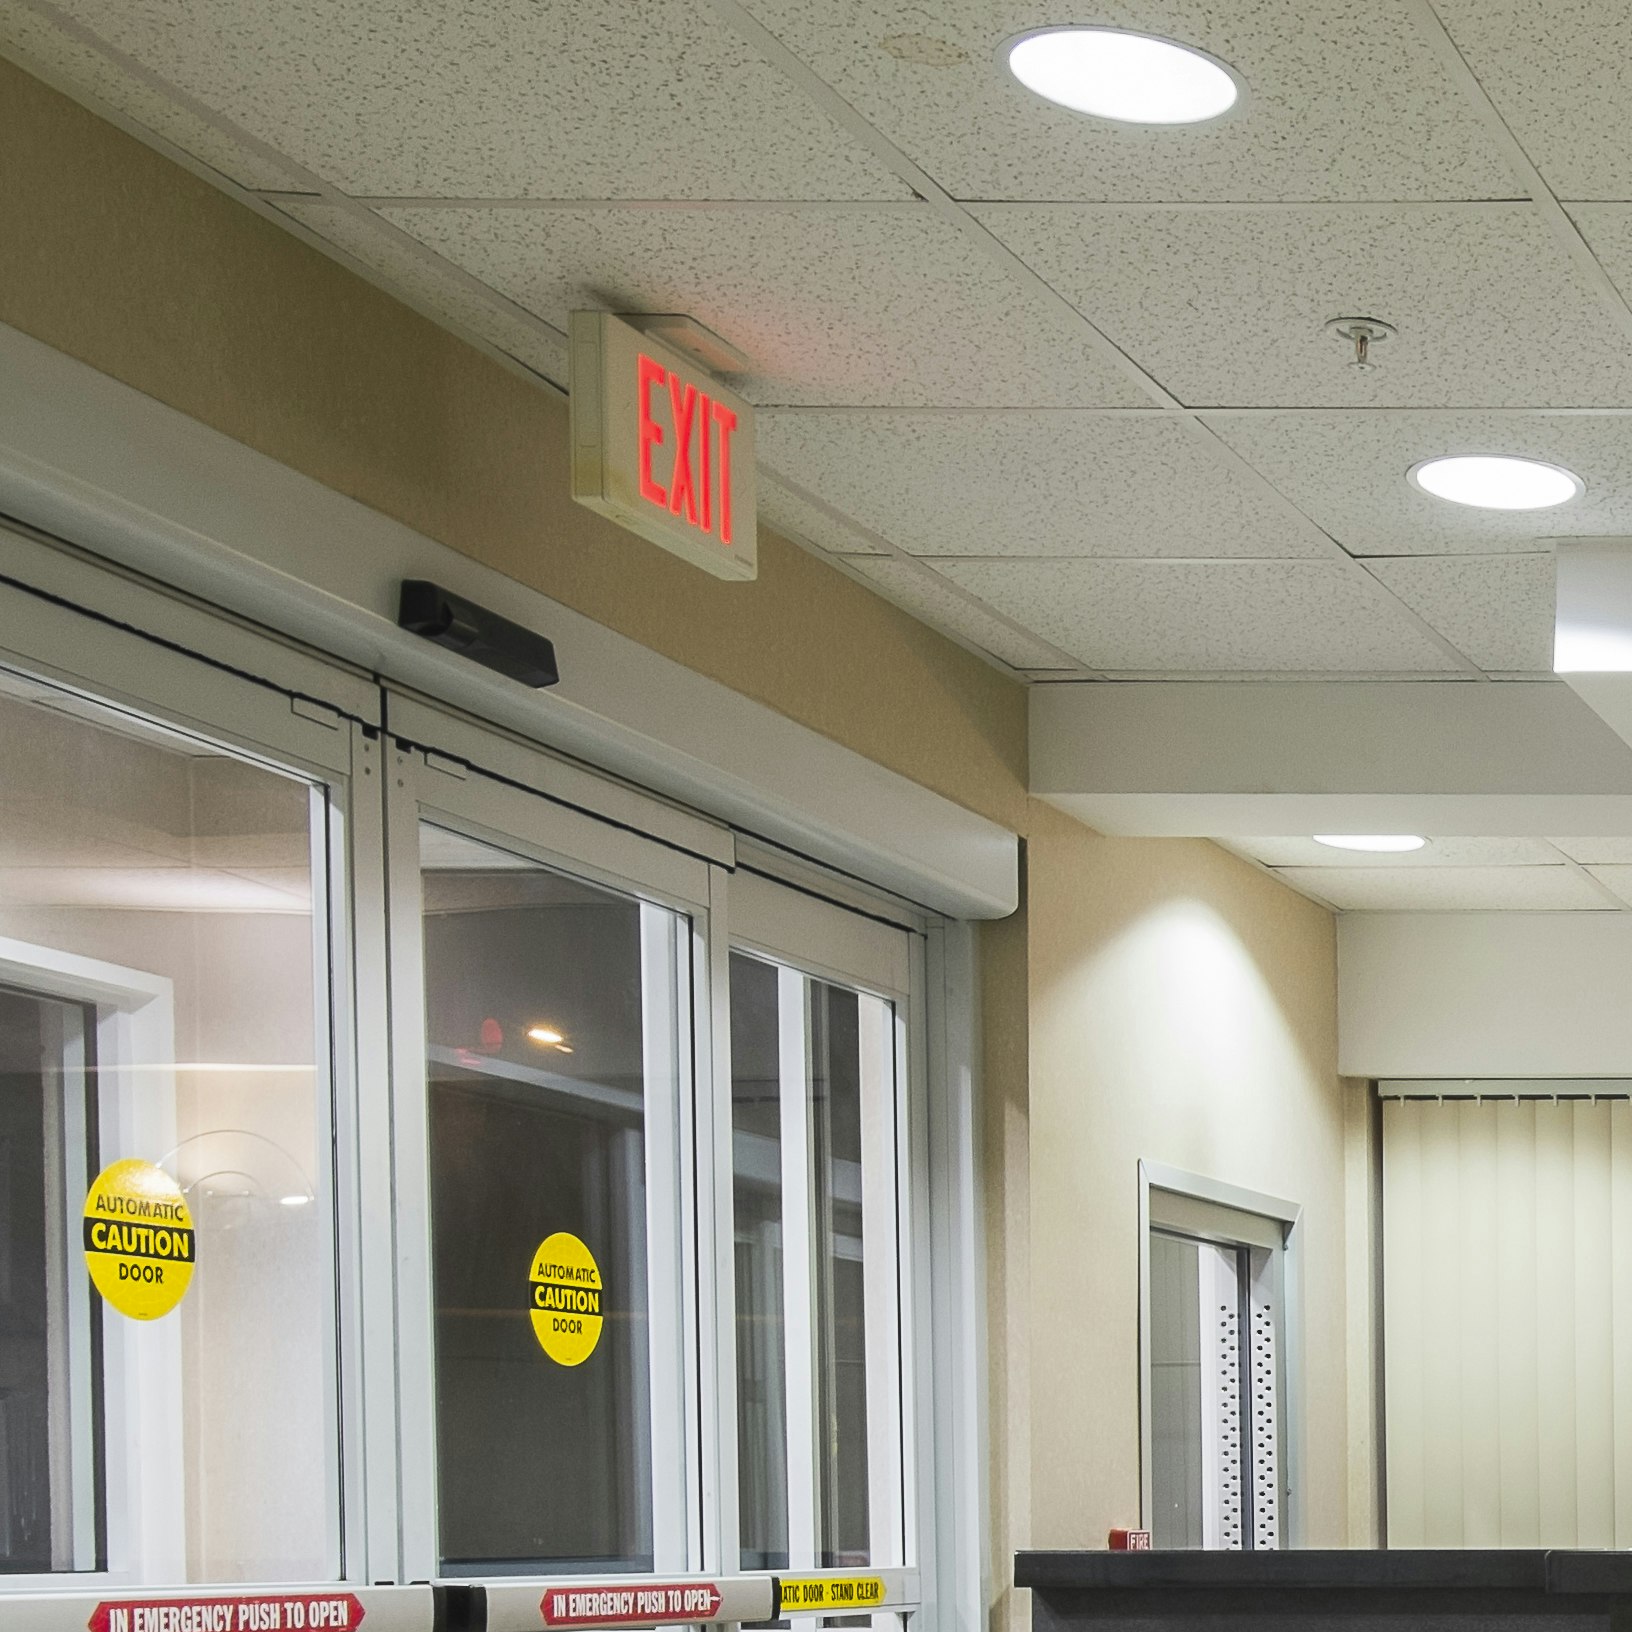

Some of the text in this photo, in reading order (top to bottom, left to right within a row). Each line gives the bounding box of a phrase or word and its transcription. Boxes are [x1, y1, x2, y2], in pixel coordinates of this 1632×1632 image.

[637, 352, 737, 546] EXIT
[95, 1194, 184, 1221] AUTOMATIC
[91, 1222, 189, 1258] CAUTION
[118, 1262, 164, 1284] DOOR
[537, 1262, 596, 1283] AUTOMATIC
[534, 1285, 600, 1313] CAUTION
[552, 1317, 583, 1334] DOOR
[1130, 1533, 1149, 1550] FIRE
[553, 1589, 711, 1617] IN EMERGENCY PUSH TO OPEN
[803, 1583, 824, 1602] DOOR
[831, 1583, 854, 1601] STAND
[857, 1581, 879, 1600] CLEAR
[237, 1601, 281, 1631] PUSH
[285, 1602, 303, 1629] TO
[308, 1600, 348, 1628] OPEN
